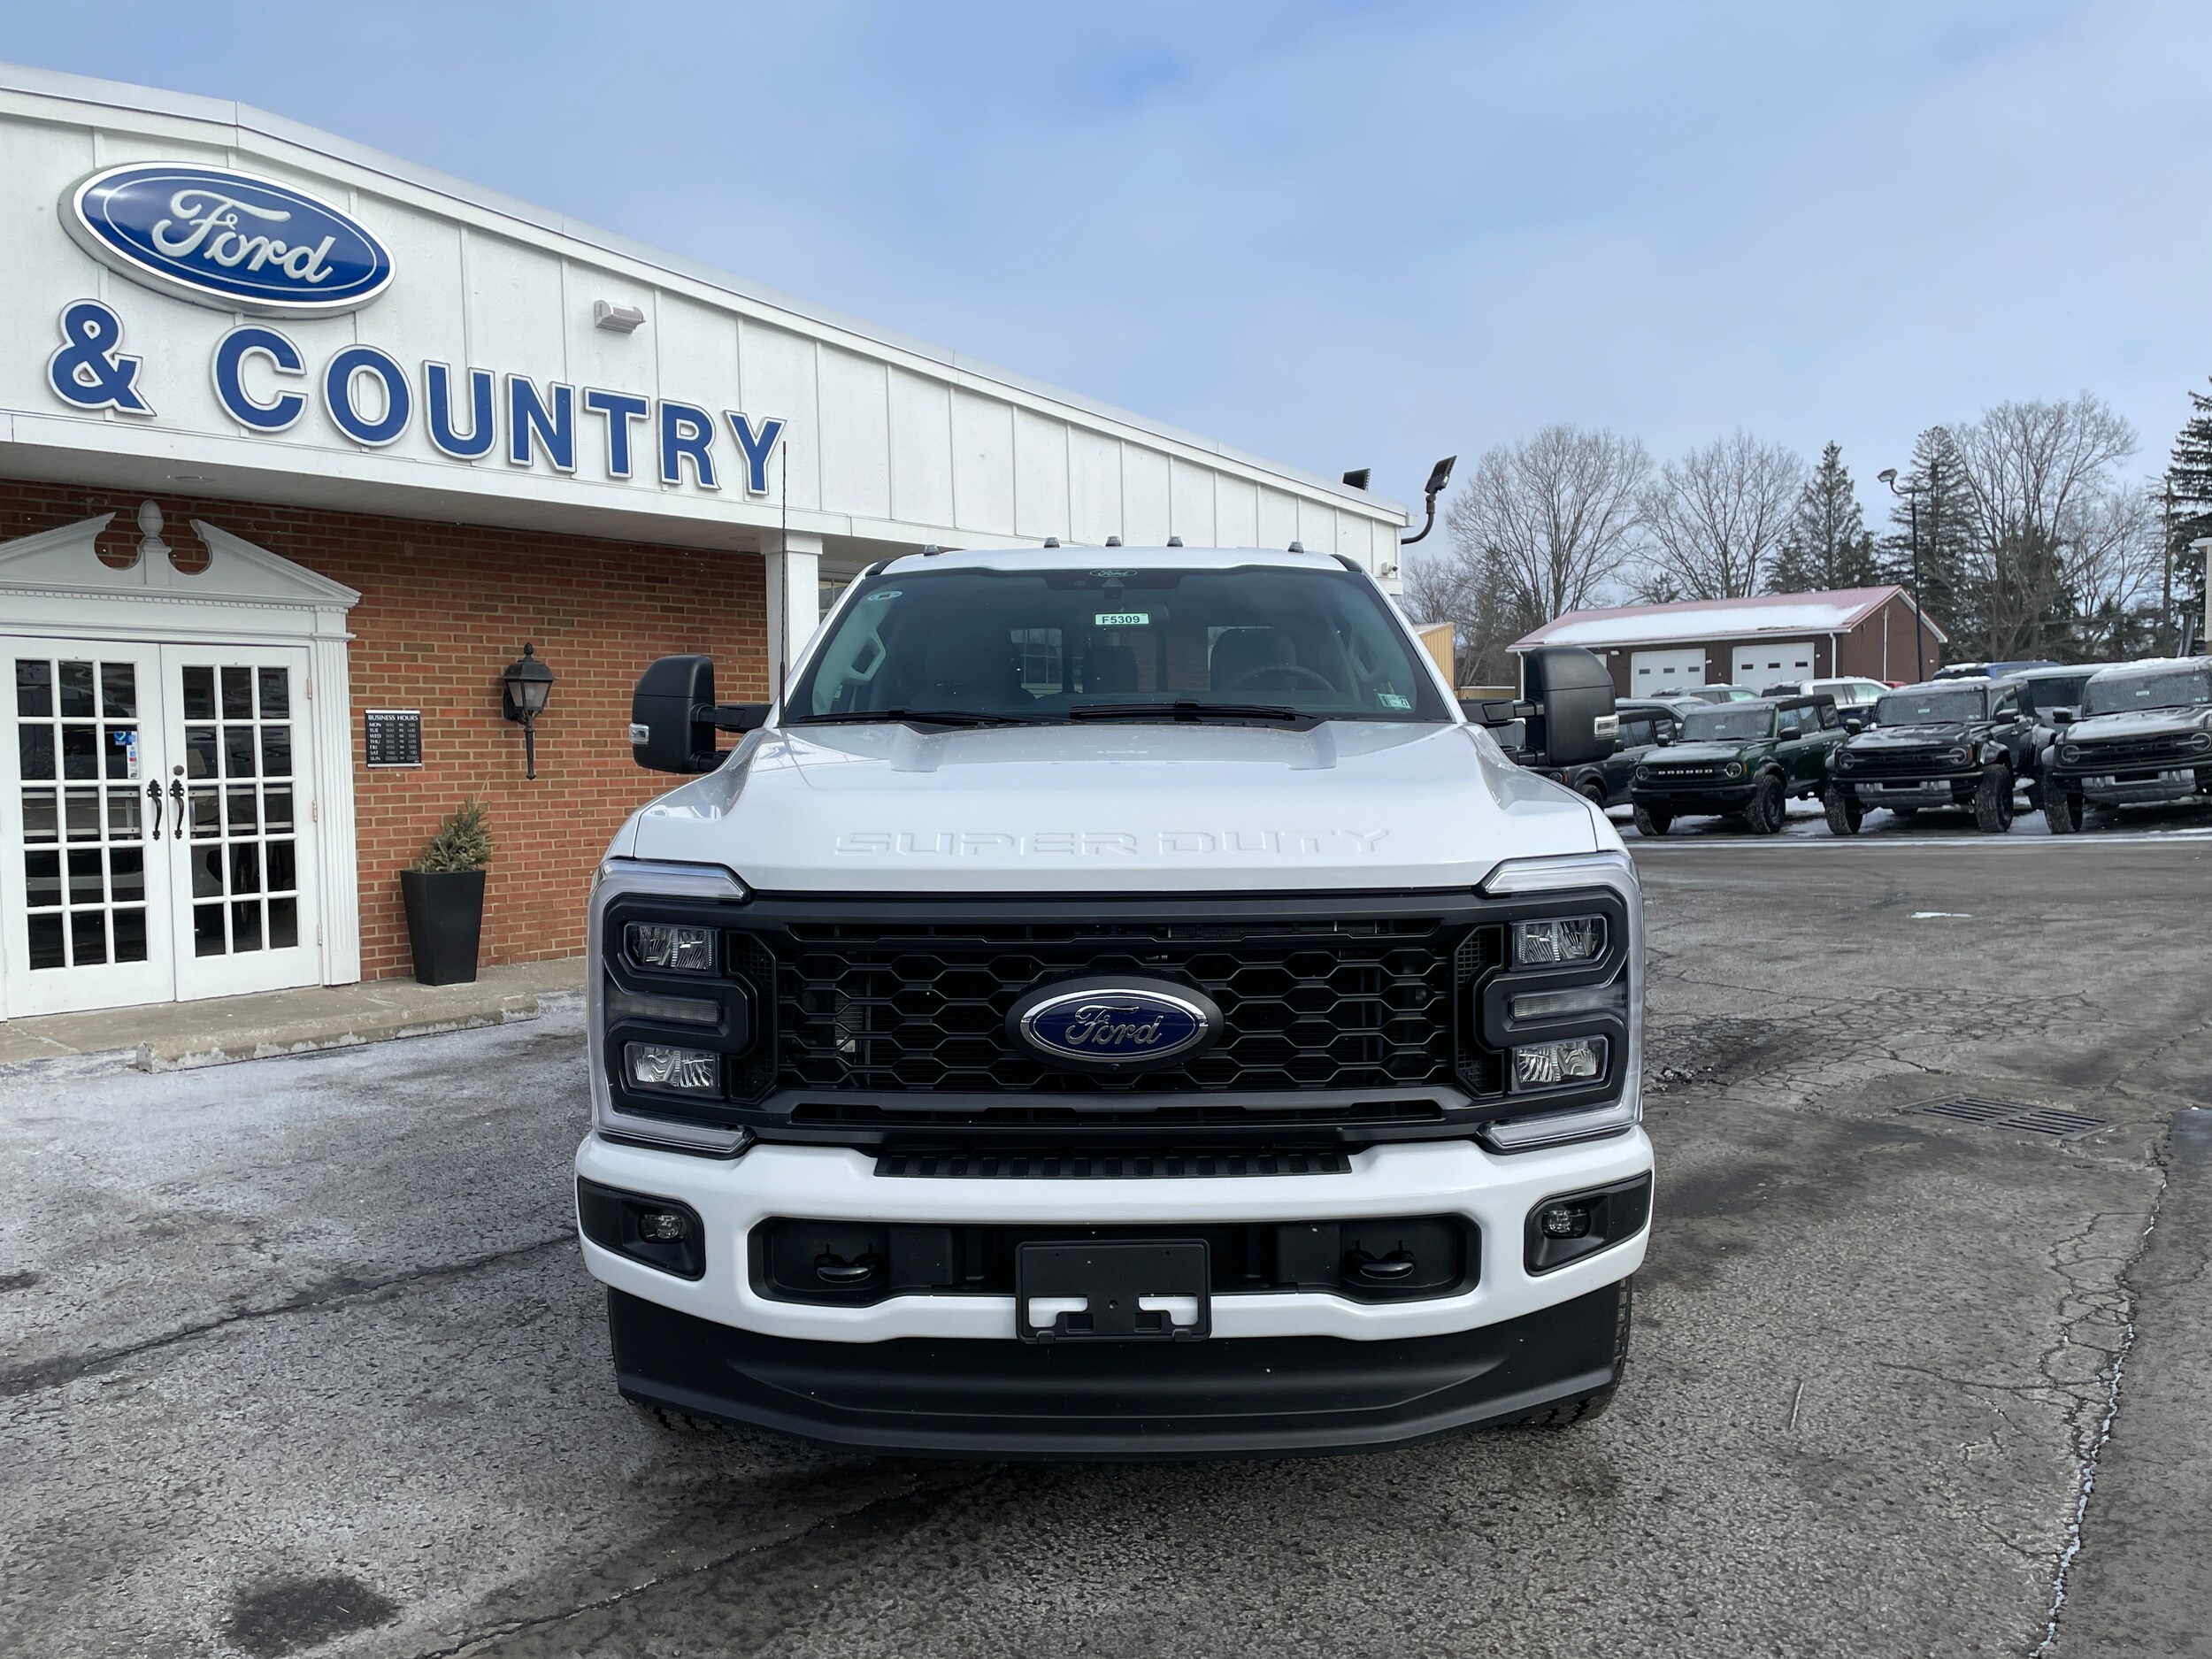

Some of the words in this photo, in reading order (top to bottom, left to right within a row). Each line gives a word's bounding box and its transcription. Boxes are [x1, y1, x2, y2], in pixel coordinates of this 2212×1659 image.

[151, 188, 338, 284] Ford
[48, 297, 157, 417] &
[211, 324, 786, 495] COUNTRY
[1102, 615, 1141, 624] F5309
[835, 832, 1138, 856] SUPER
[1157, 829, 1390, 856] DUTY
[1065, 1004, 1164, 1045] Ford
